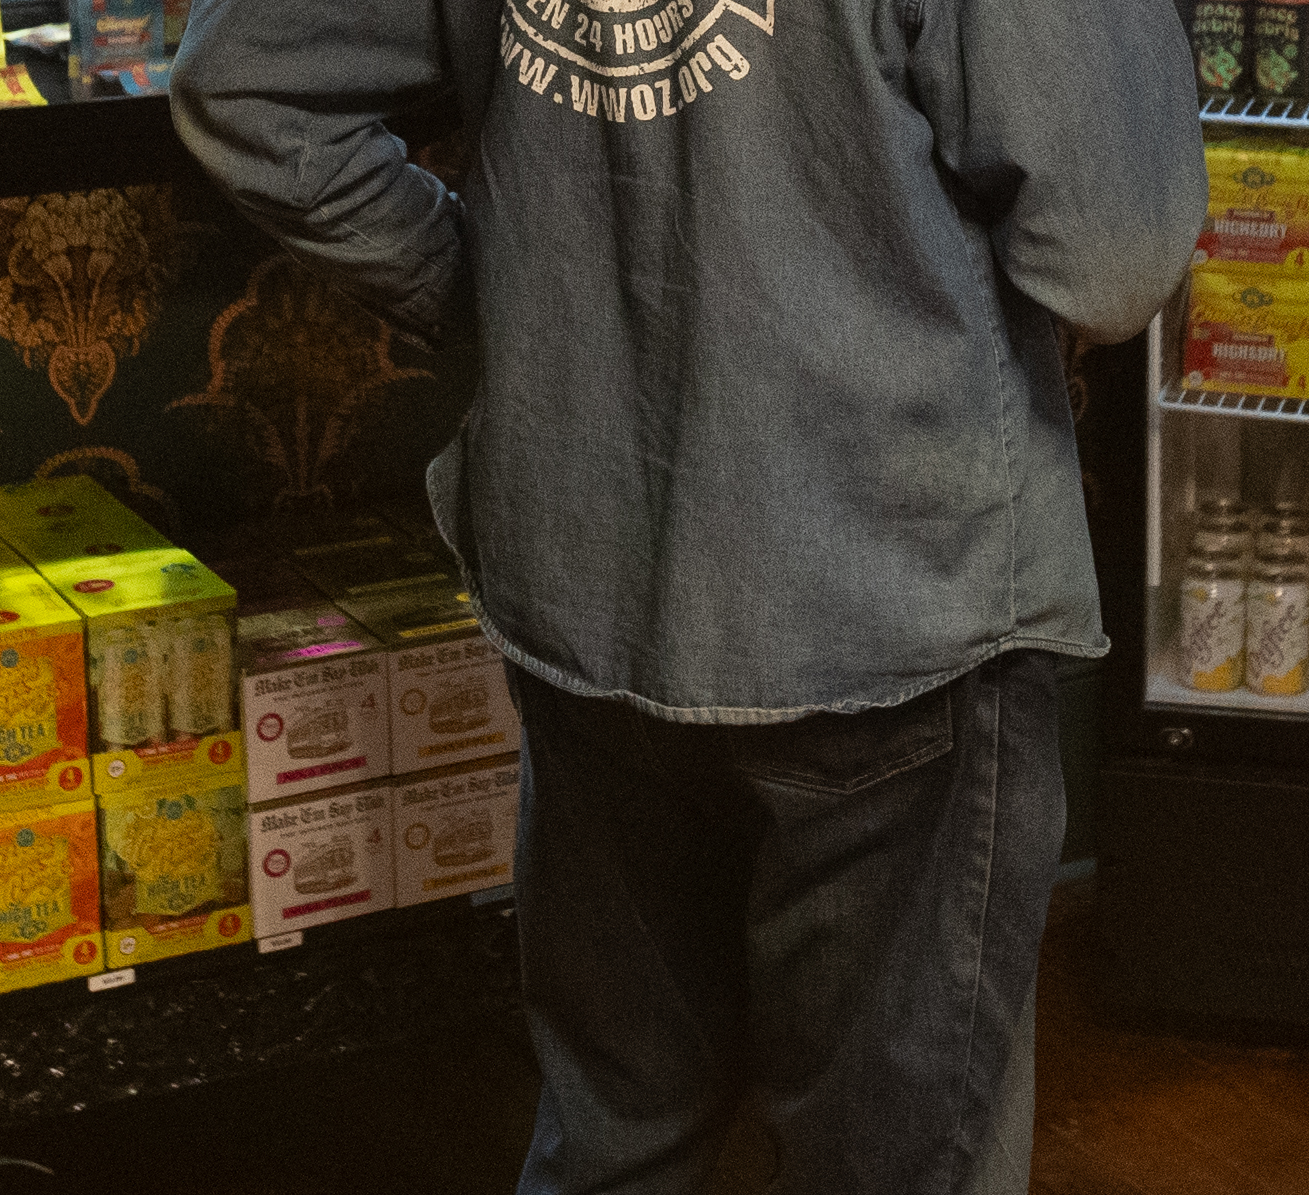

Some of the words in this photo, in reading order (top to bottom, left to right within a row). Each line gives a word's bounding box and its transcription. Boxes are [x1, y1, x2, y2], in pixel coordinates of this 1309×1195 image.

[573, 13, 604, 54] 24
[1213, 218, 1288, 239] HIGH&DRY
[1295, 251, 1304, 267] 4
[1211, 342, 1286, 363] HIGH&DRY
[1298, 374, 1306, 391] 4
[20, 723, 46, 740] TEA
[35, 899, 61, 918] TEA
